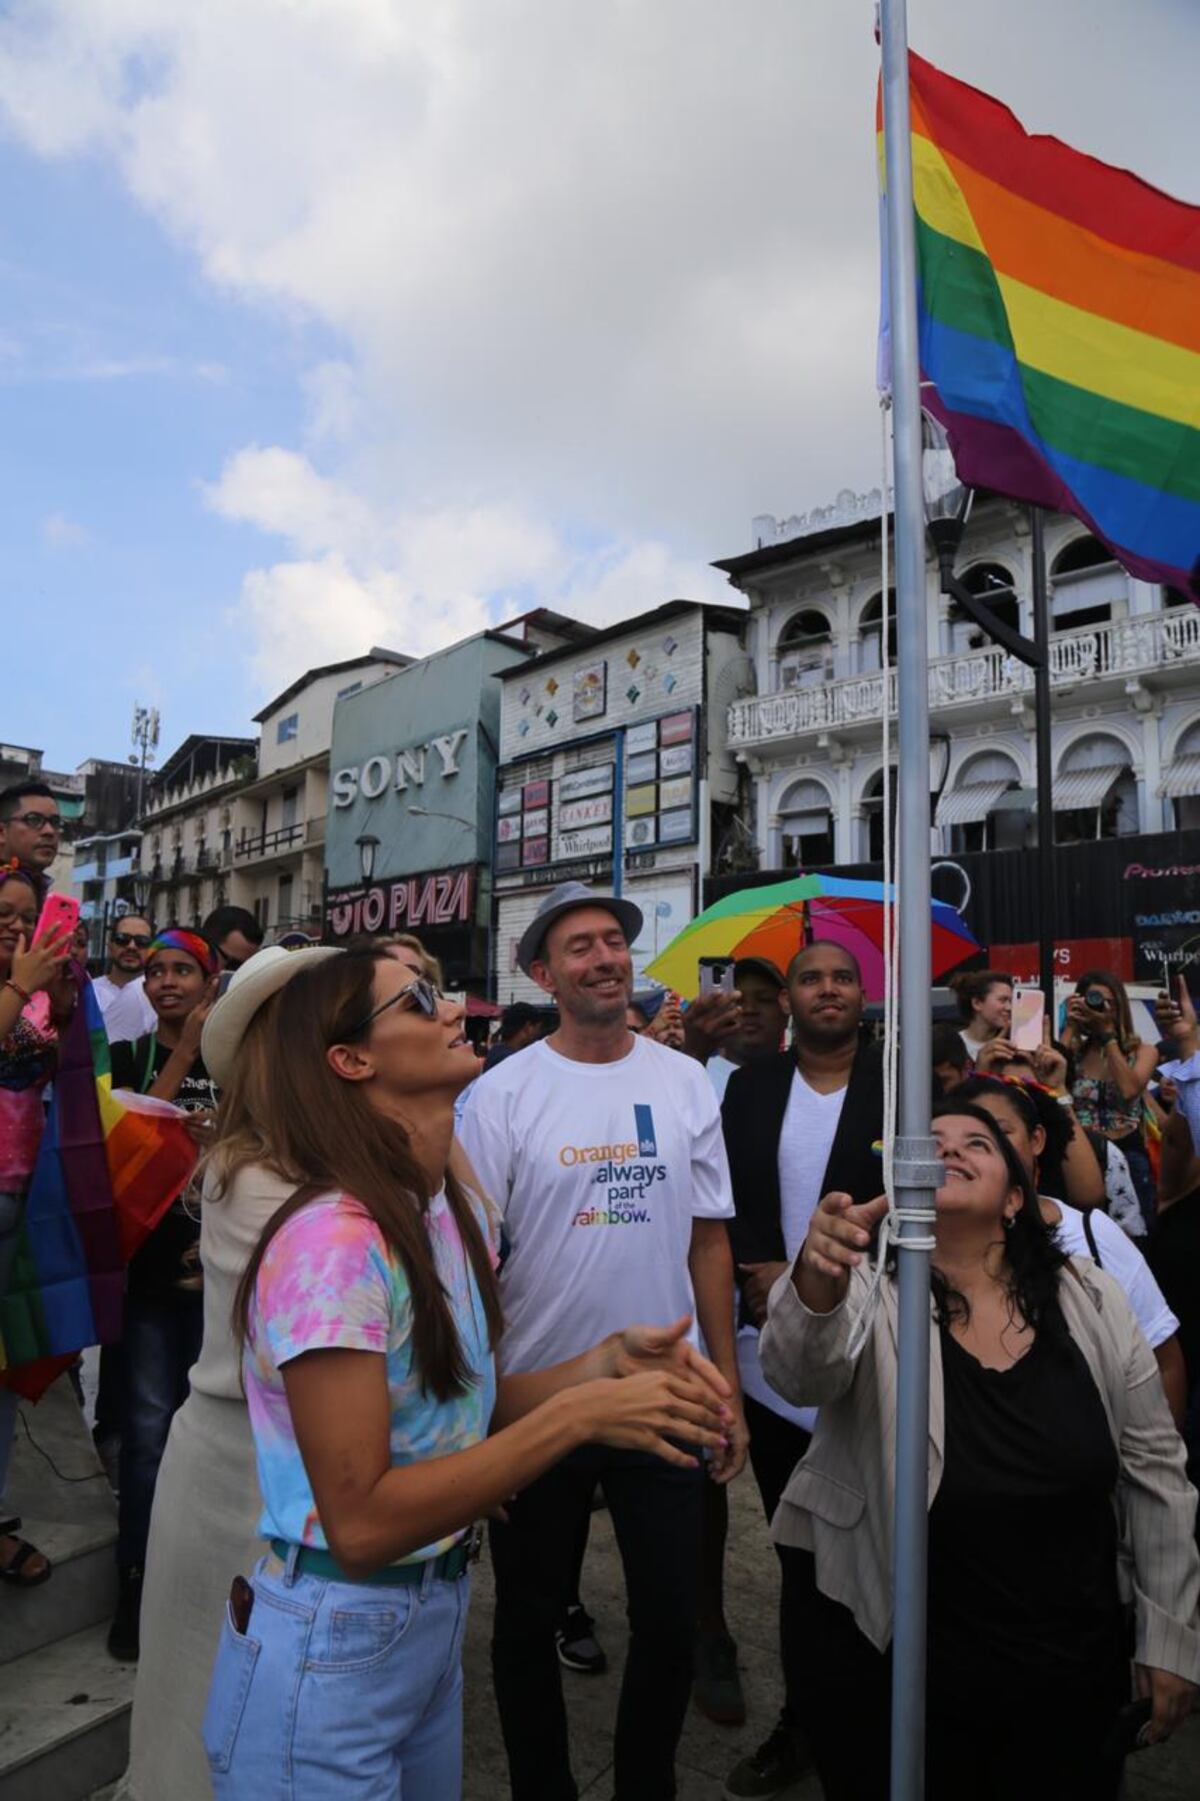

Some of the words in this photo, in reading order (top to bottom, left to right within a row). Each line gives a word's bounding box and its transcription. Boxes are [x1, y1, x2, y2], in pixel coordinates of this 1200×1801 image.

[332, 729, 468, 808] SONY
[561, 801, 609, 823] SANKEY
[565, 834, 610, 856] Whirlpool
[389, 871, 469, 930] PLAZA
[560, 1143, 637, 1165] Orange
[596, 1161, 666, 1186] always
[608, 1183, 645, 1204] part
[572, 1207, 651, 1226] rainbow.
